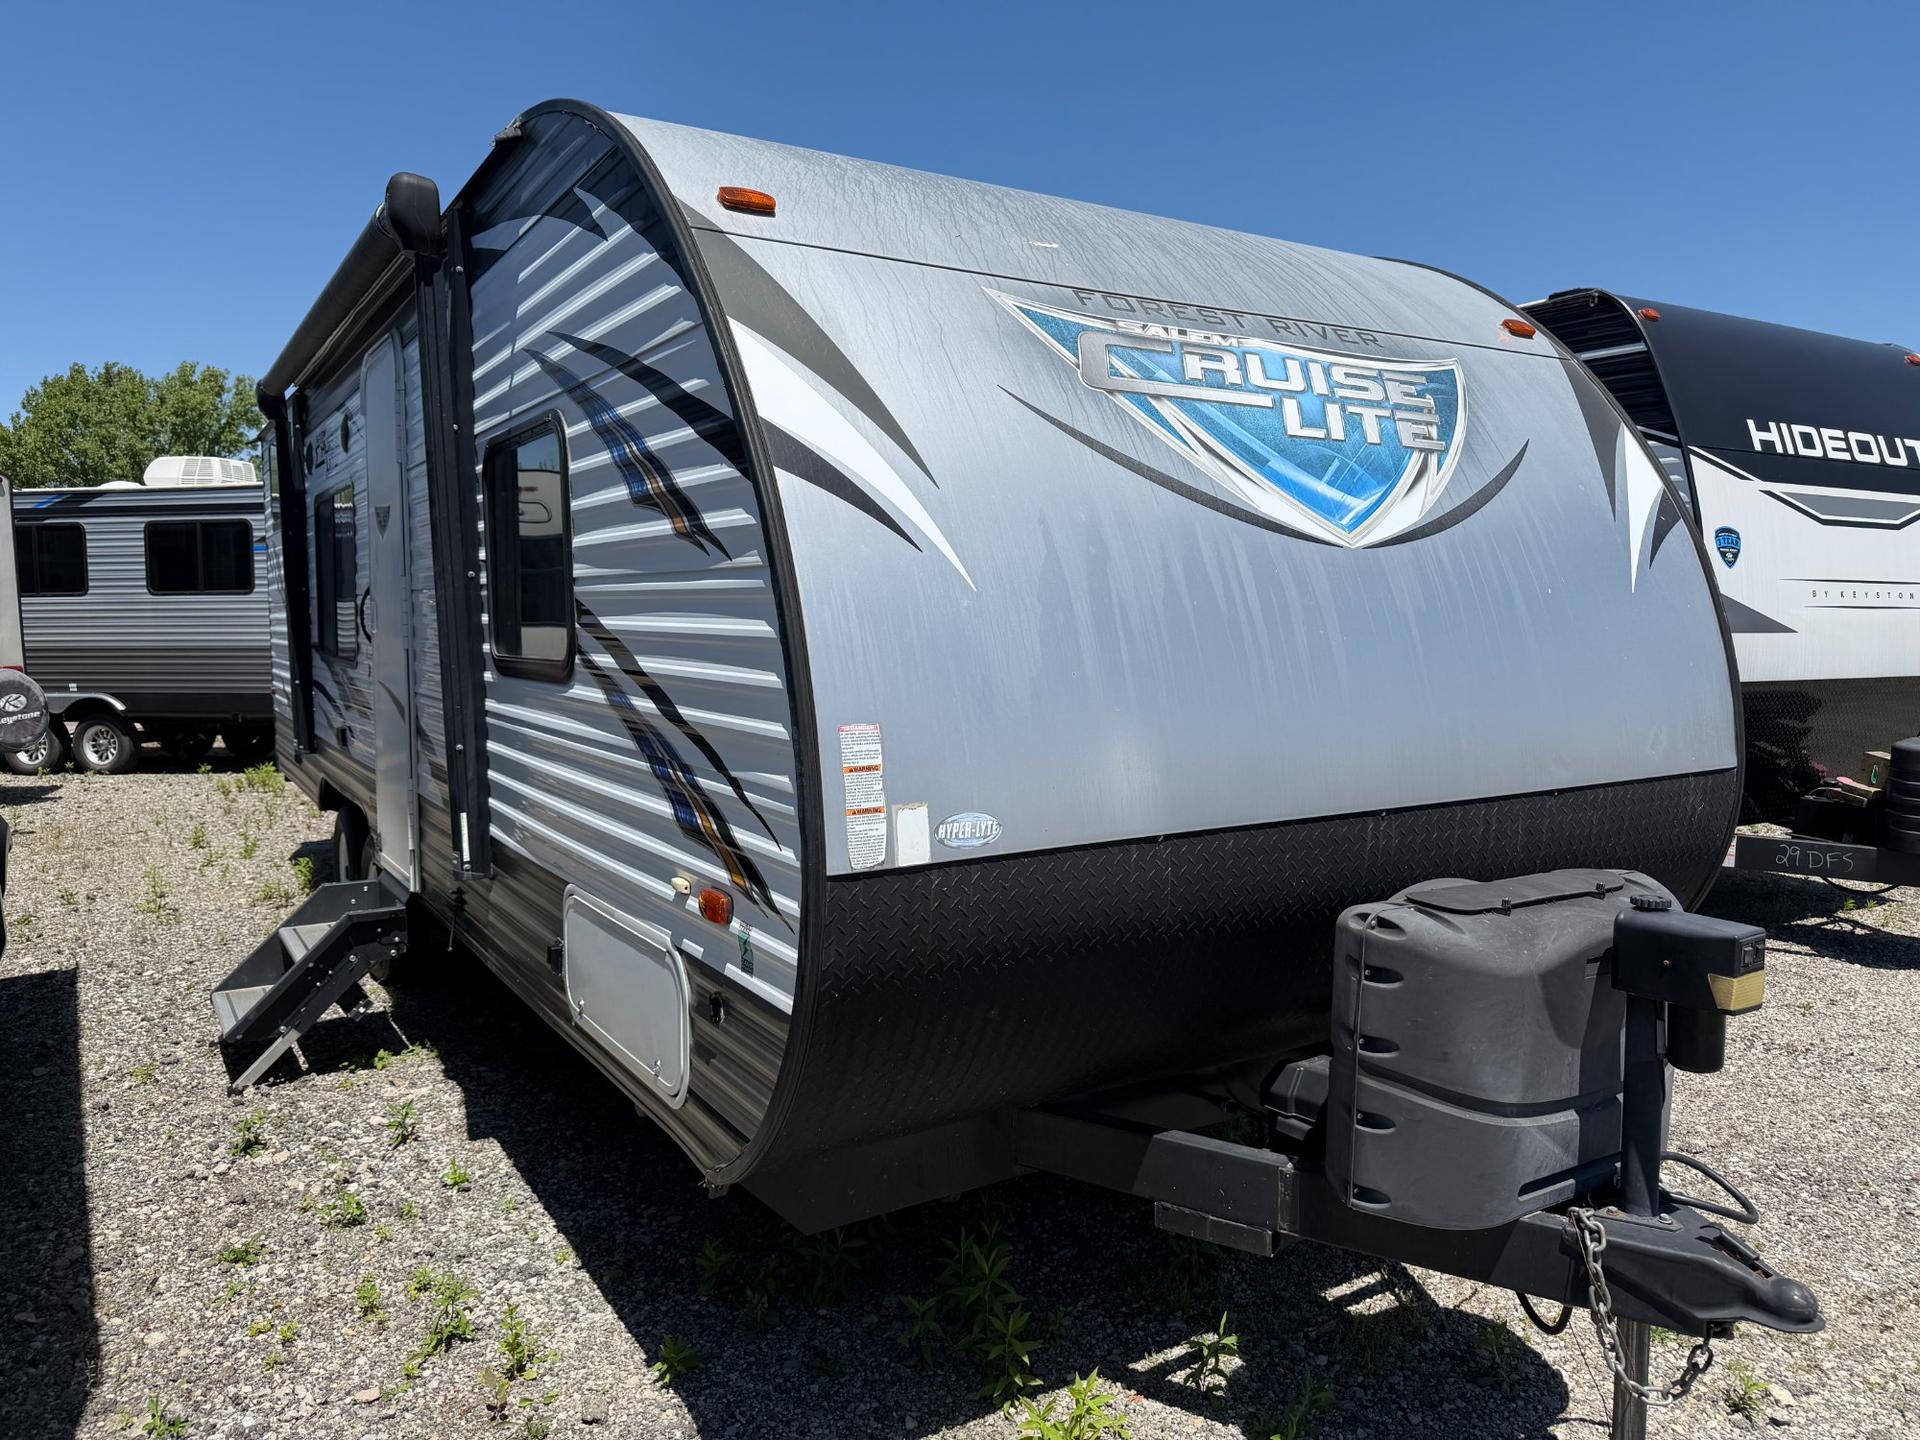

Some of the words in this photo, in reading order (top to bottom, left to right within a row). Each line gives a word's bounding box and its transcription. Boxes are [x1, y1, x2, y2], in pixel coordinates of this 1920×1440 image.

[1072, 289, 1246, 329] FOREST
[1270, 318, 1381, 349] RIVER
[1116, 320, 1240, 347] SALEM
[1078, 330, 1430, 408] CRUISE
[1281, 395, 1446, 452] LITE
[1746, 418, 1920, 467] HIDEOUT
[1812, 590, 1829, 598] BY
[0, 711, 40, 724] eystone
[856, 807, 881, 815] WARNING
[938, 821, 1000, 838] HYPER-LYTE
